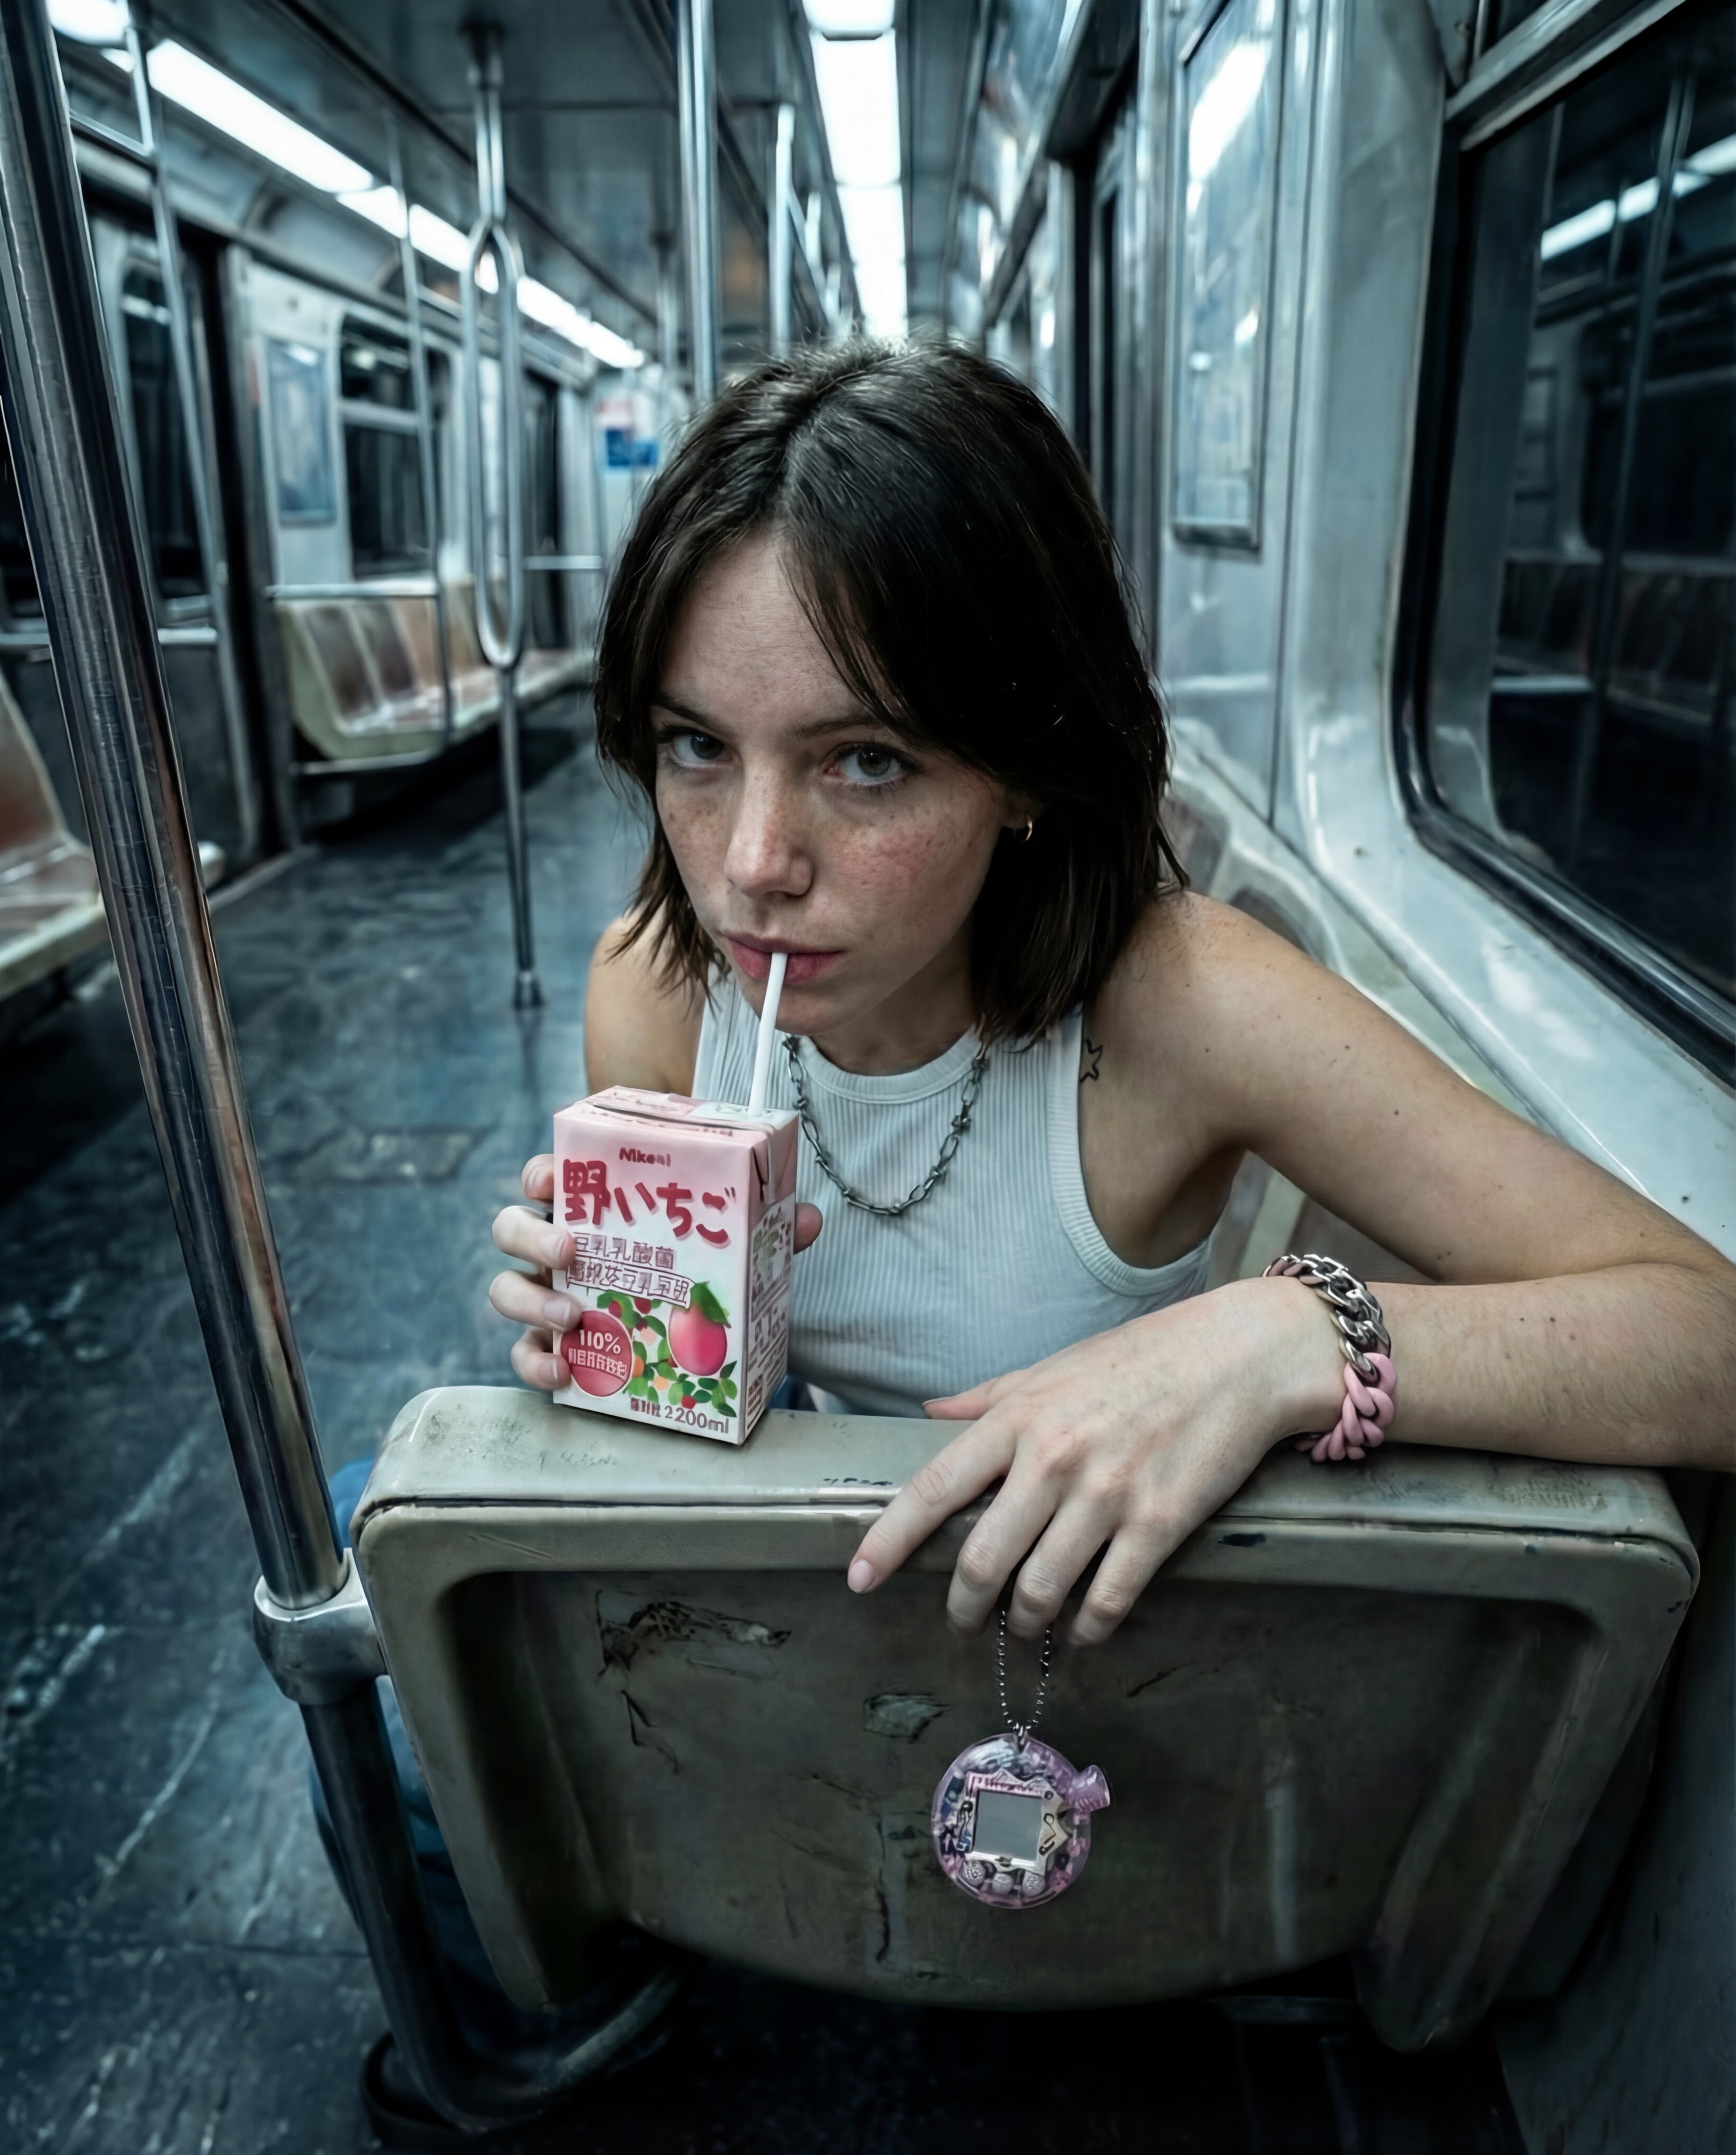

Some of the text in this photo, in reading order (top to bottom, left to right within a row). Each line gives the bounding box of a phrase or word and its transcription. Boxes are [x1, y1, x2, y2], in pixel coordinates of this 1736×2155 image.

[563, 1159, 736, 1245] 野いちご
[579, 1329, 621, 1354] 110%
